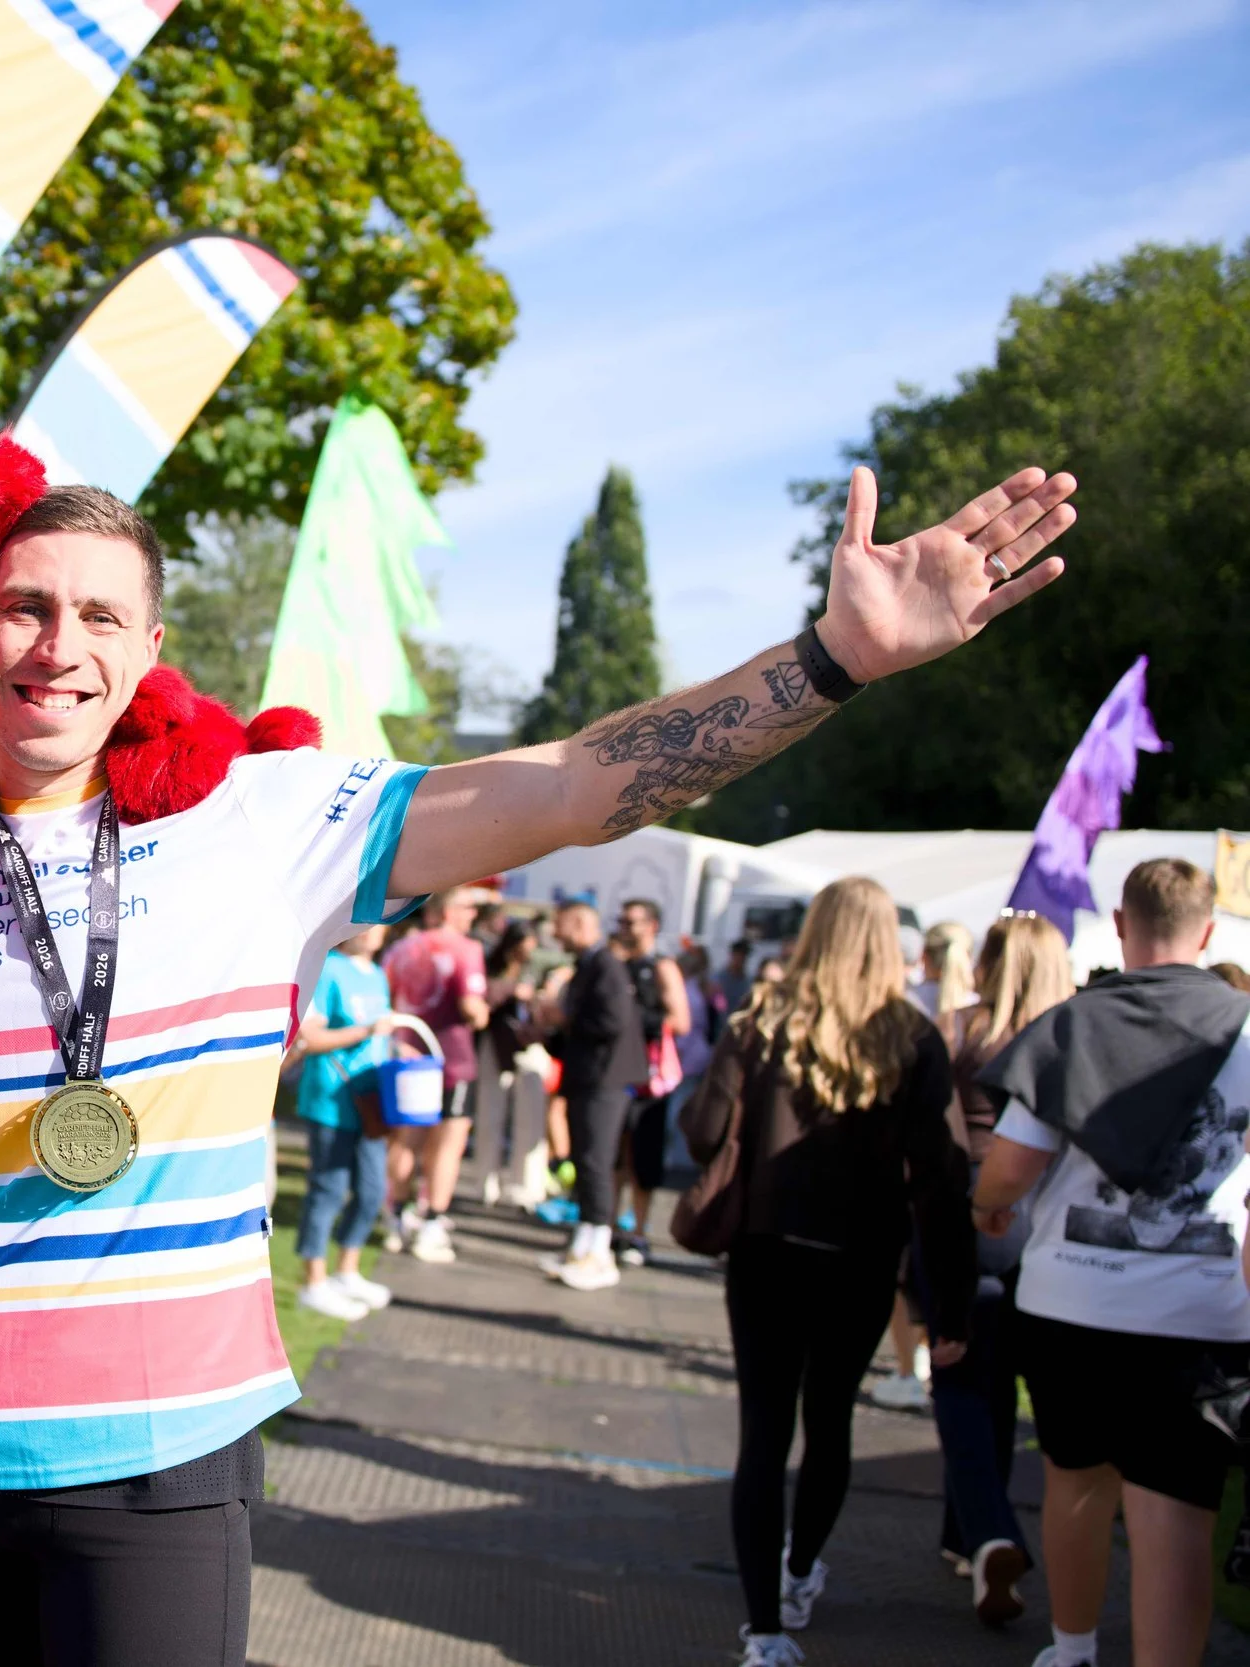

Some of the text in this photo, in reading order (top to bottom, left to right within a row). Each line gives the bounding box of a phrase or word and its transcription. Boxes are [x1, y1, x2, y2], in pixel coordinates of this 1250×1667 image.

[98, 823, 110, 863] CARDIFF
[10, 846, 41, 915] CARDIFF HALF
[35, 937, 54, 970] 2026
[94, 953, 109, 988] 2026
[76, 1011, 96, 1079] RDIFF HALF
[90, 1040, 100, 1073] MARATHON
